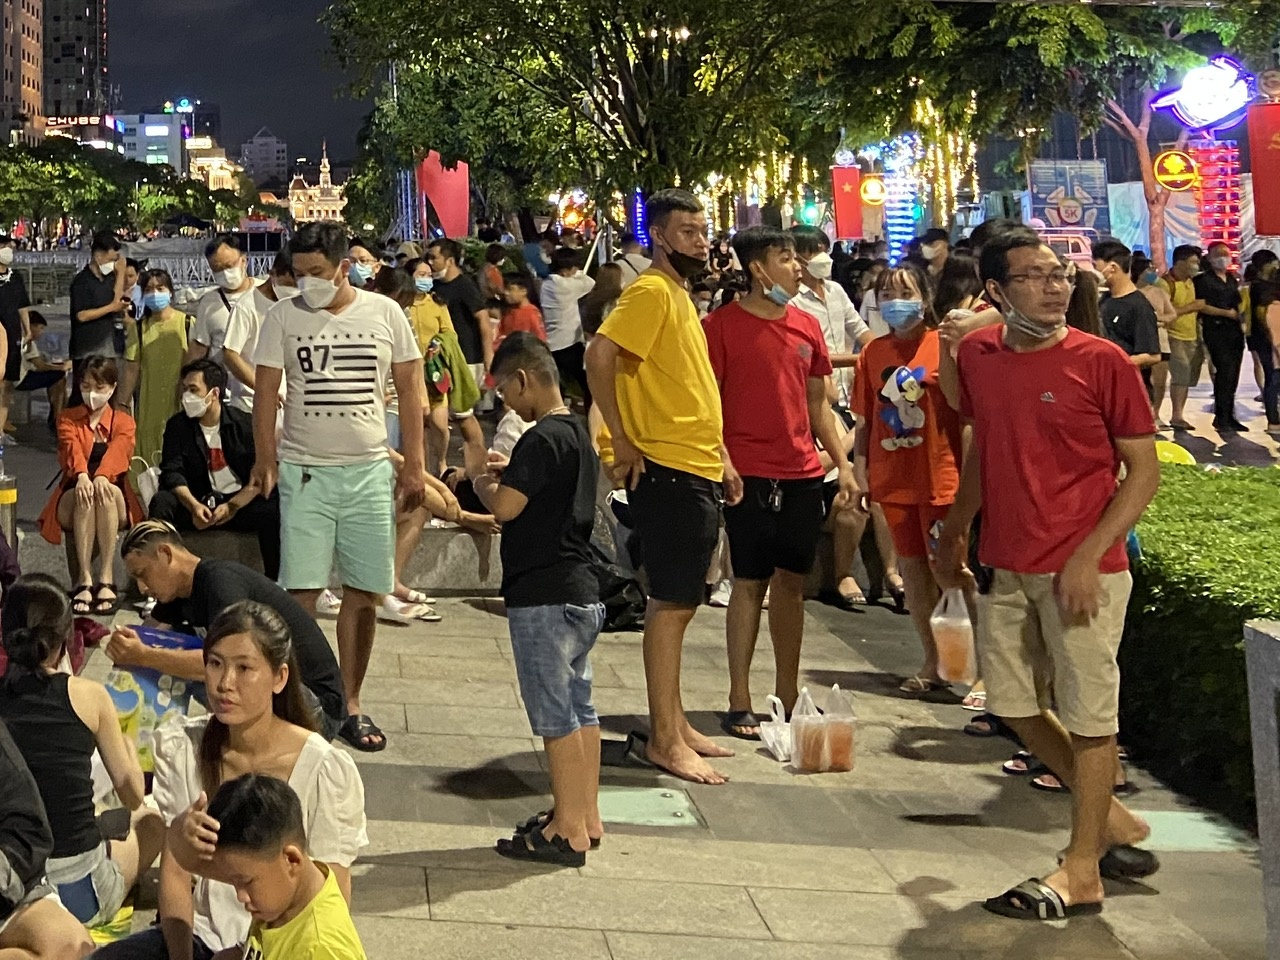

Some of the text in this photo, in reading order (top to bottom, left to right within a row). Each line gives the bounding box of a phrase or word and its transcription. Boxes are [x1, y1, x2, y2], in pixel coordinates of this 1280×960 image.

[47, 116, 101, 126] CHUBB
[1064, 208, 1078, 219] 5K
[297, 345, 330, 373] 87
